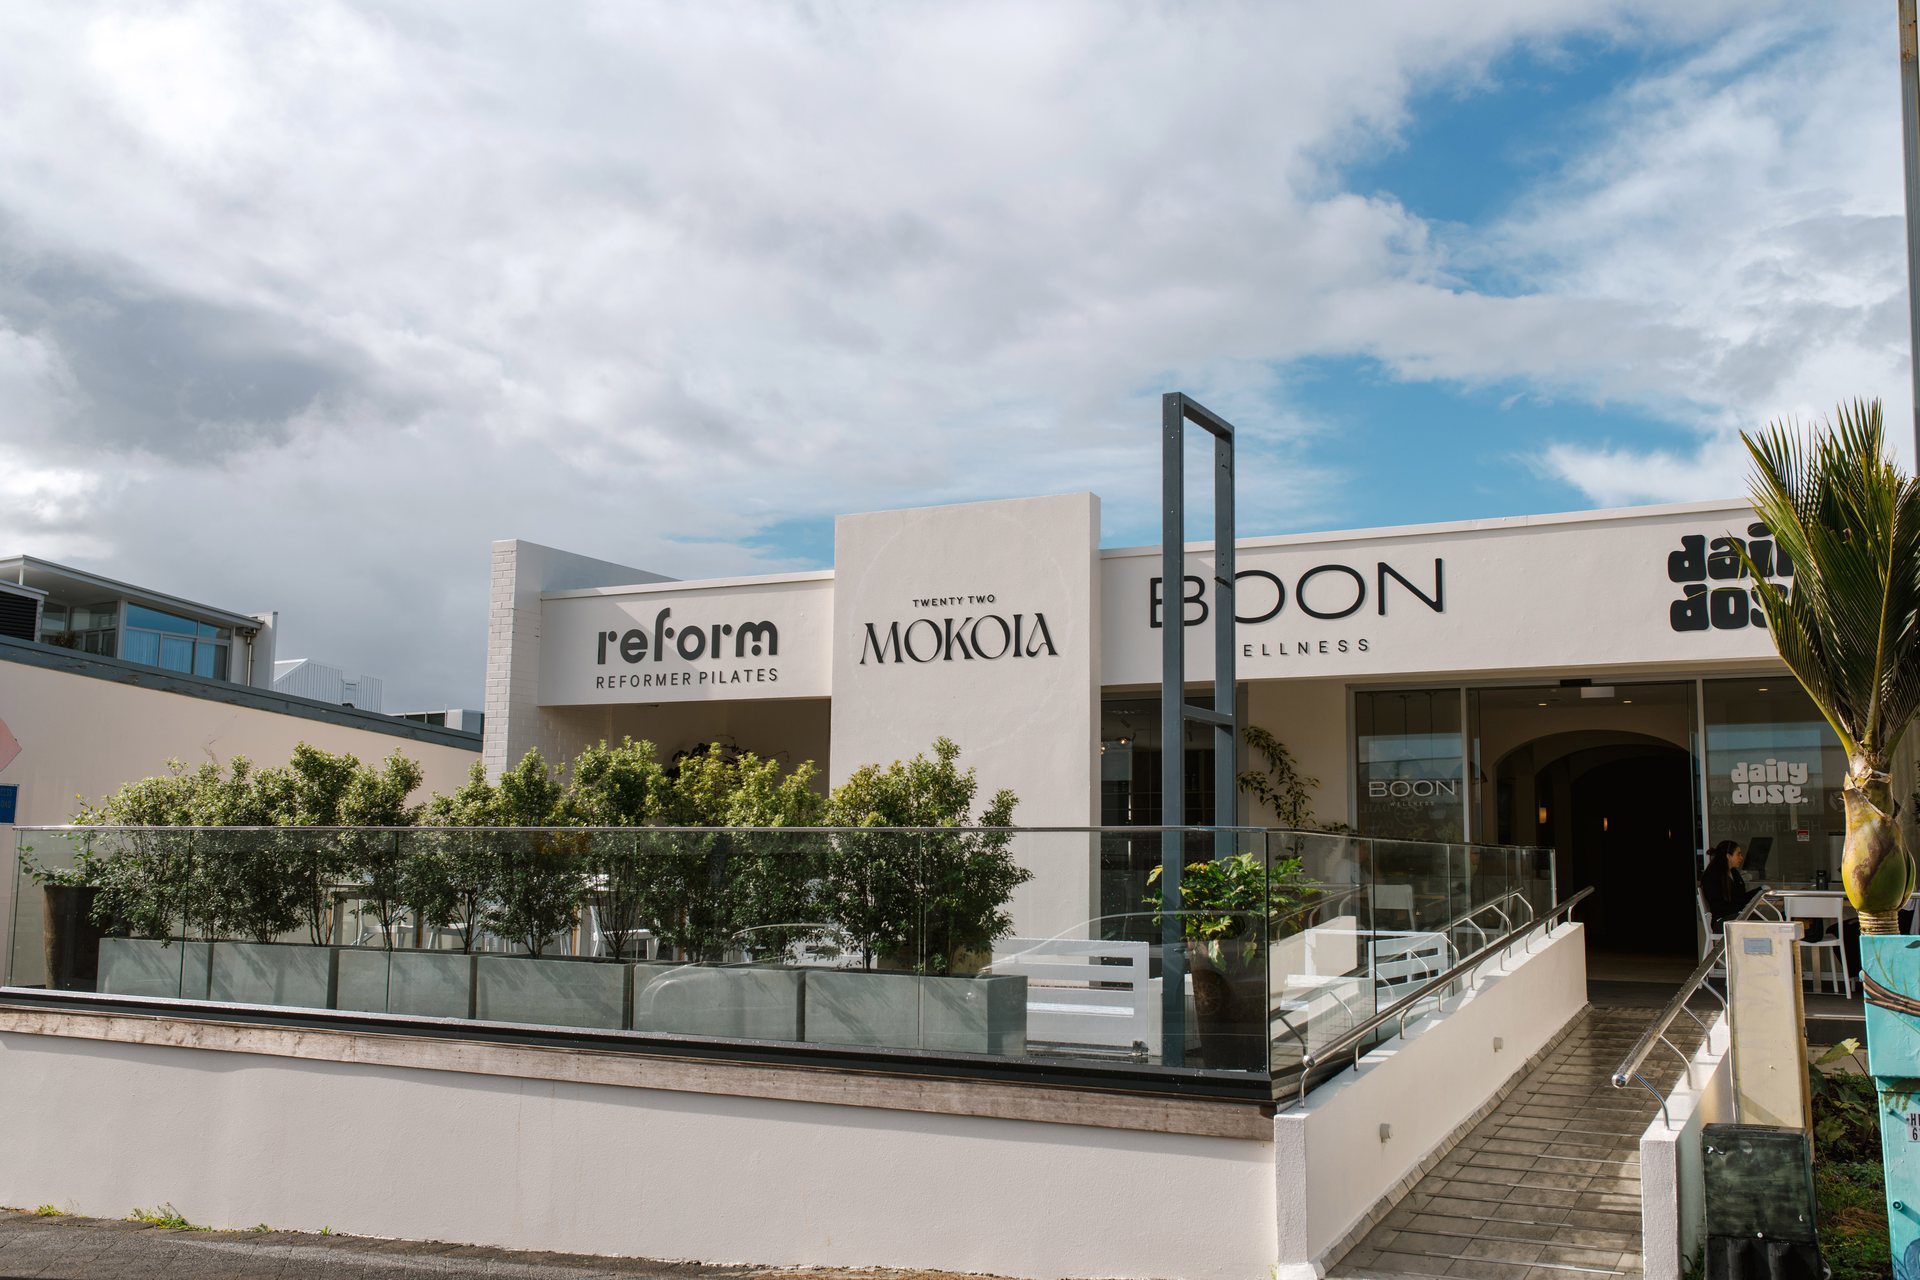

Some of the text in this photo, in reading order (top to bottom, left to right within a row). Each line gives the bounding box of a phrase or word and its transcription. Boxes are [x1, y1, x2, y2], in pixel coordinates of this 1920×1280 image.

[1667, 522, 1796, 582] dail
[912, 593, 996, 608] TWENTY TWO
[1150, 558, 1444, 629] BOON
[597, 607, 778, 666] reform
[859, 612, 1058, 665] MOKOIA
[1243, 638, 1369, 657] ELLNESS
[596, 667, 778, 689] REFORMER PILATES
[1731, 758, 1808, 785] daily
[1368, 779, 1455, 797] BOON
[1732, 783, 1809, 804] dose.
